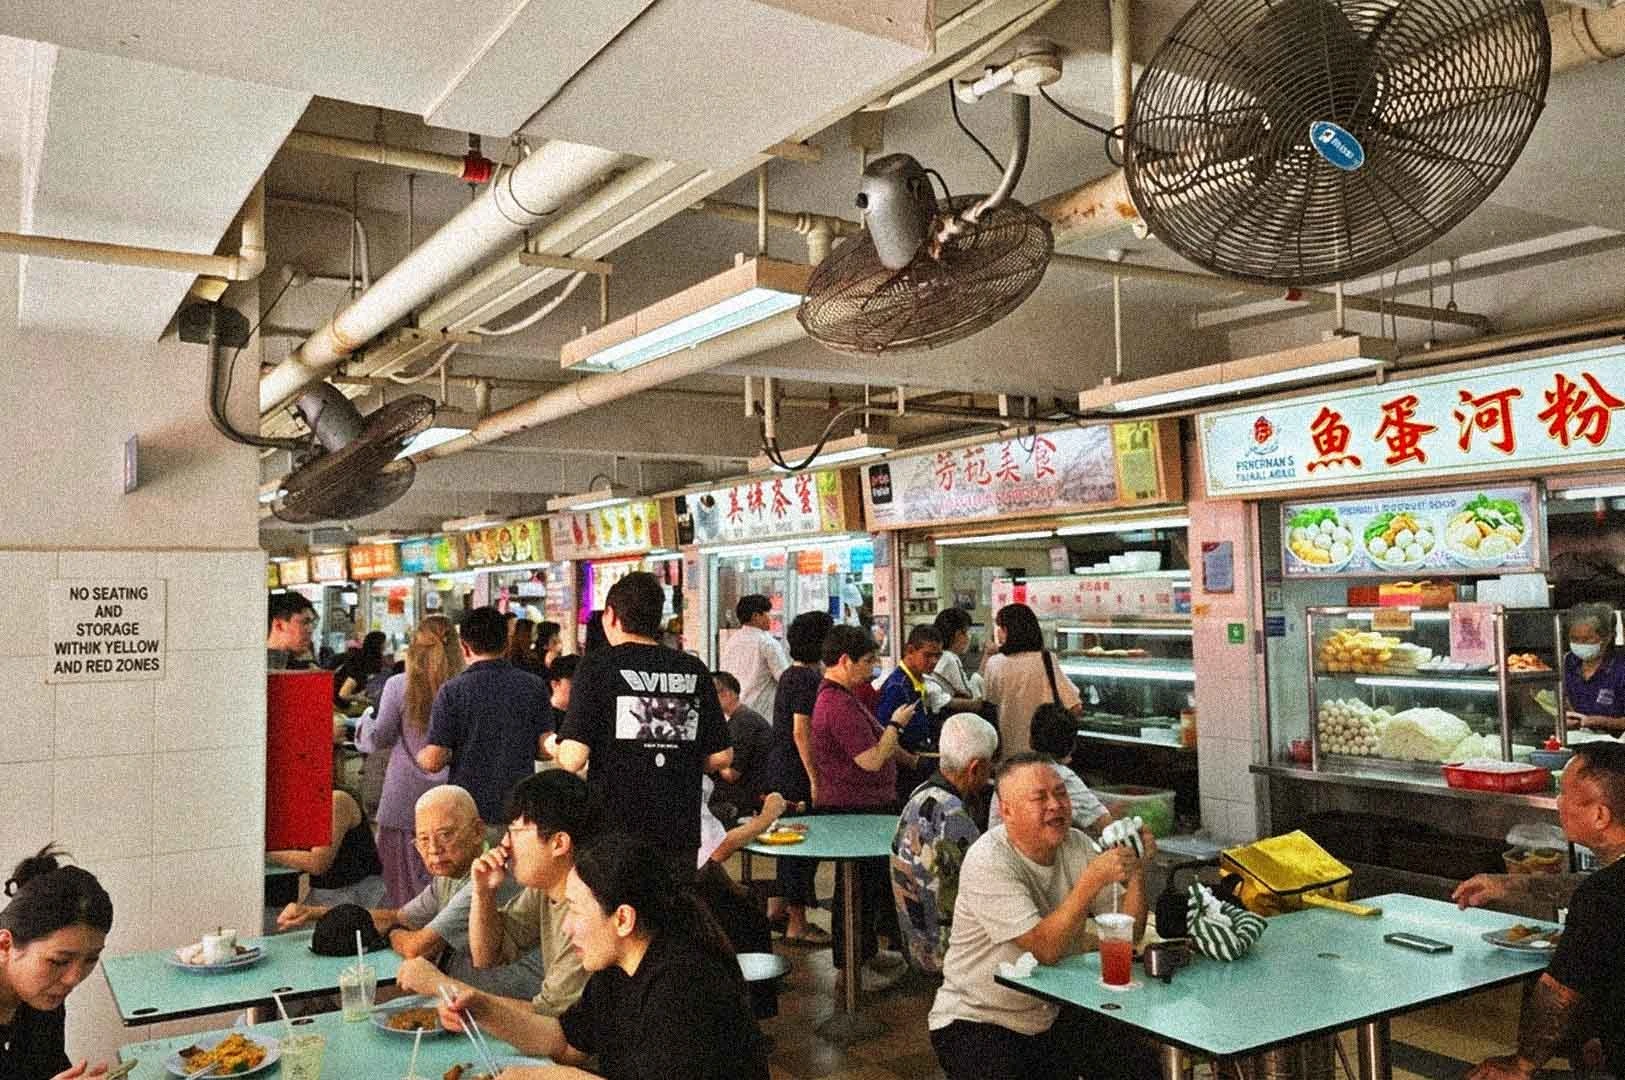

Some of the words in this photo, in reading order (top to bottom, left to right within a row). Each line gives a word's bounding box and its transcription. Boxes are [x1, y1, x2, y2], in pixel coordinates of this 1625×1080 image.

[1307, 372, 1625, 472] 魚蛋河粉
[70, 587, 89, 600] NO
[92, 587, 148, 600] SEATING
[94, 605, 122, 618] AND
[76, 622, 139, 636] STORAGE
[104, 640, 159, 654] YELLOW
[54, 661, 82, 674] AND
[86, 660, 112, 673] RED
[115, 658, 160, 672] ZONES
